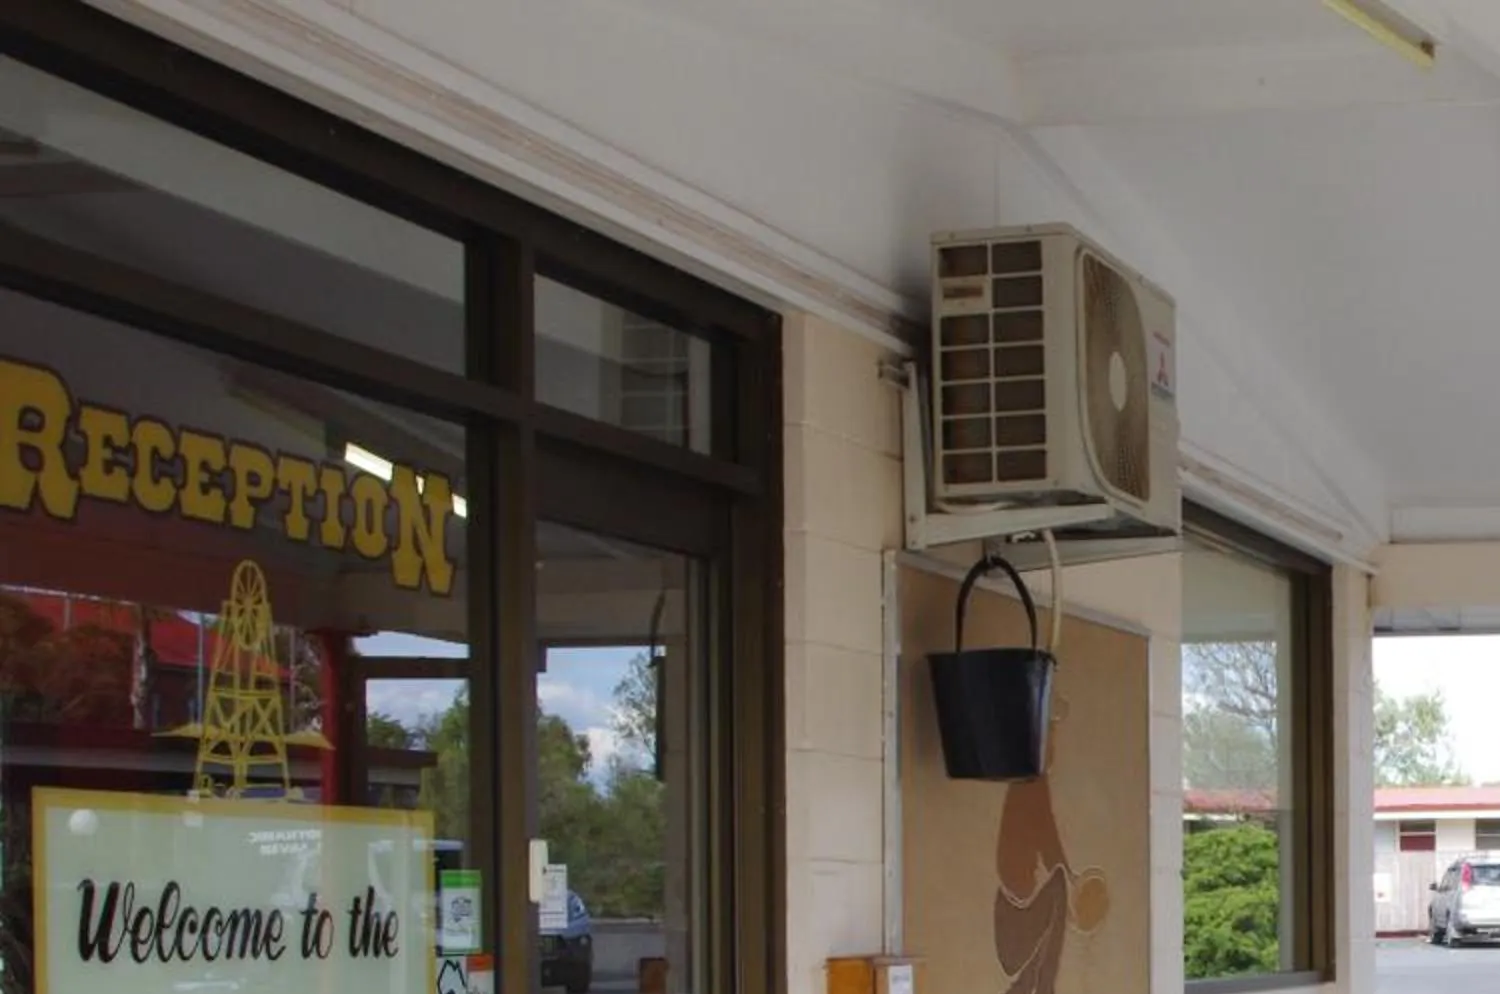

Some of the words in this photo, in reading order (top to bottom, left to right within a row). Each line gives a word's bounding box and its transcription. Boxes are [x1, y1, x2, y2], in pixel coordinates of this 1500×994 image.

[0, 357, 458, 597] RECEPTION
[77, 878, 286, 964] Welcome
[300, 892, 334, 961] to
[348, 885, 399, 959] the
